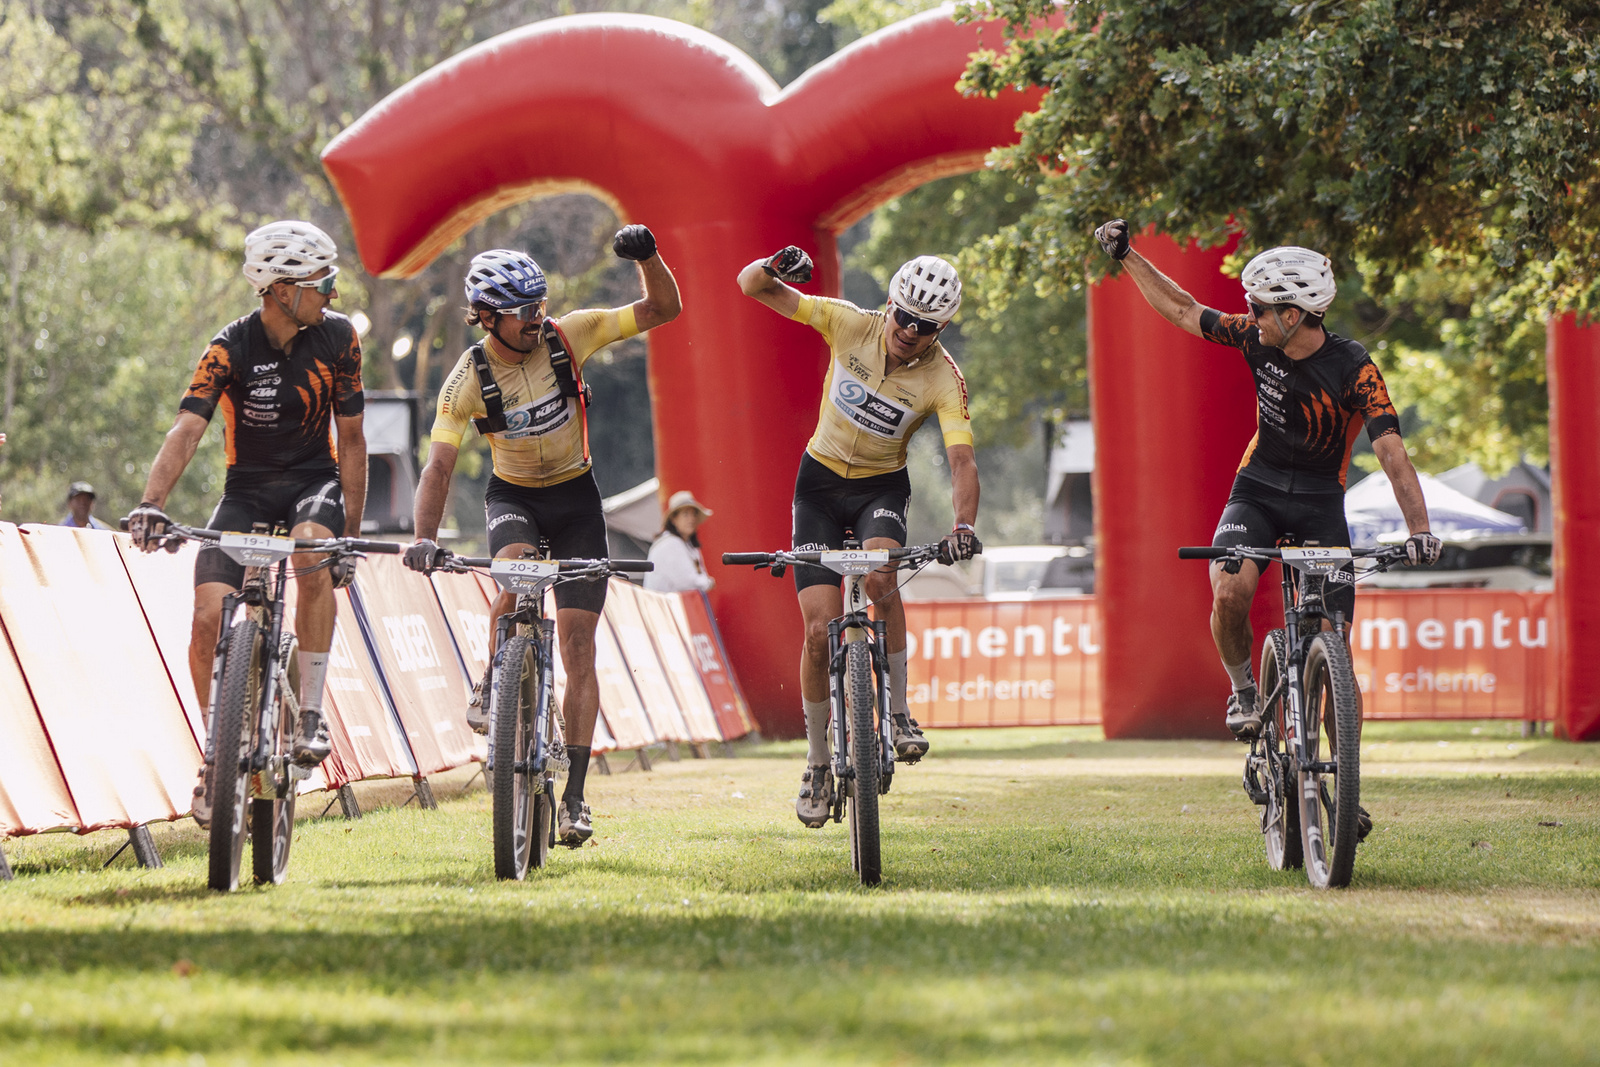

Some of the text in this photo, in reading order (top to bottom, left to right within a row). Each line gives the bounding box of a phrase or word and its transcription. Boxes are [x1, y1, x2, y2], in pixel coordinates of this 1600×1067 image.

[478, 292, 503, 306] pure
[1275, 293, 1295, 301] ABUS
[249, 387, 278, 397] KTM
[1259, 382, 1284, 402] KTM
[867, 401, 898, 420] KTM
[858, 416, 869, 426] KTM
[870, 421, 890, 435] RACING
[242, 537, 271, 547] 19-1
[509, 563, 539, 573] 20-2
[906, 616, 1101, 661] mentu
[1350, 610, 1549, 651] mentu
[945, 673, 1056, 703] scheme
[1384, 665, 1498, 694] scheme
